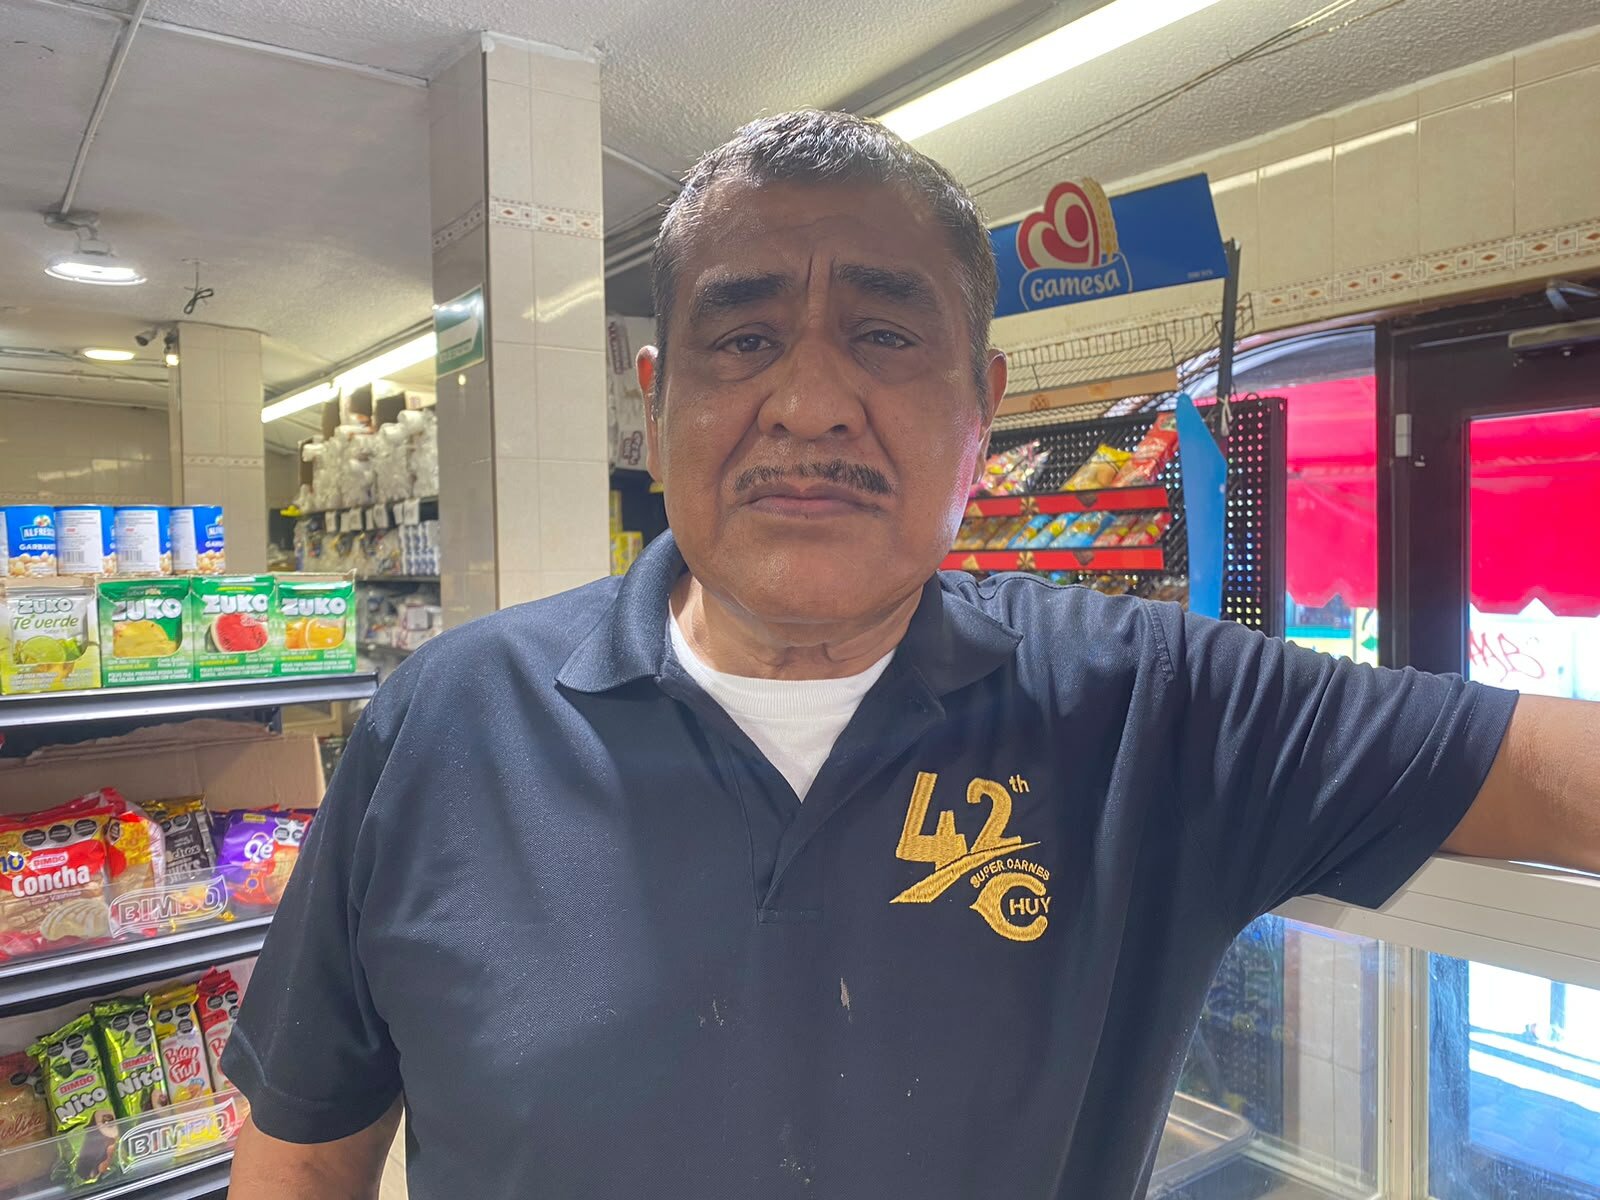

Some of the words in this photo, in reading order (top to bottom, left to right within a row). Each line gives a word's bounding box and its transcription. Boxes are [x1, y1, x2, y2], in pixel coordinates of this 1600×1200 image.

[1030, 269, 1121, 303] Gamesa
[18, 598, 73, 615] ZUKO
[111, 598, 182, 621] ZUKO
[201, 594, 268, 614] ZUKO
[281, 597, 347, 616] ZUKO
[13, 614, 35, 631] Té
[35, 615, 79, 629] verde
[33, 854, 66, 868] BIMBO
[11, 865, 90, 898] Concha
[970, 859, 1005, 888] SUPER
[118, 886, 221, 926] BIMBO
[120, 1054, 155, 1070] BIMBO
[164, 1046, 200, 1065] Bran
[59, 1075, 95, 1094] BIMBO
[116, 1067, 165, 1099] Nito
[55, 1087, 107, 1123] Nito
[127, 1110, 231, 1159] BIMBO
